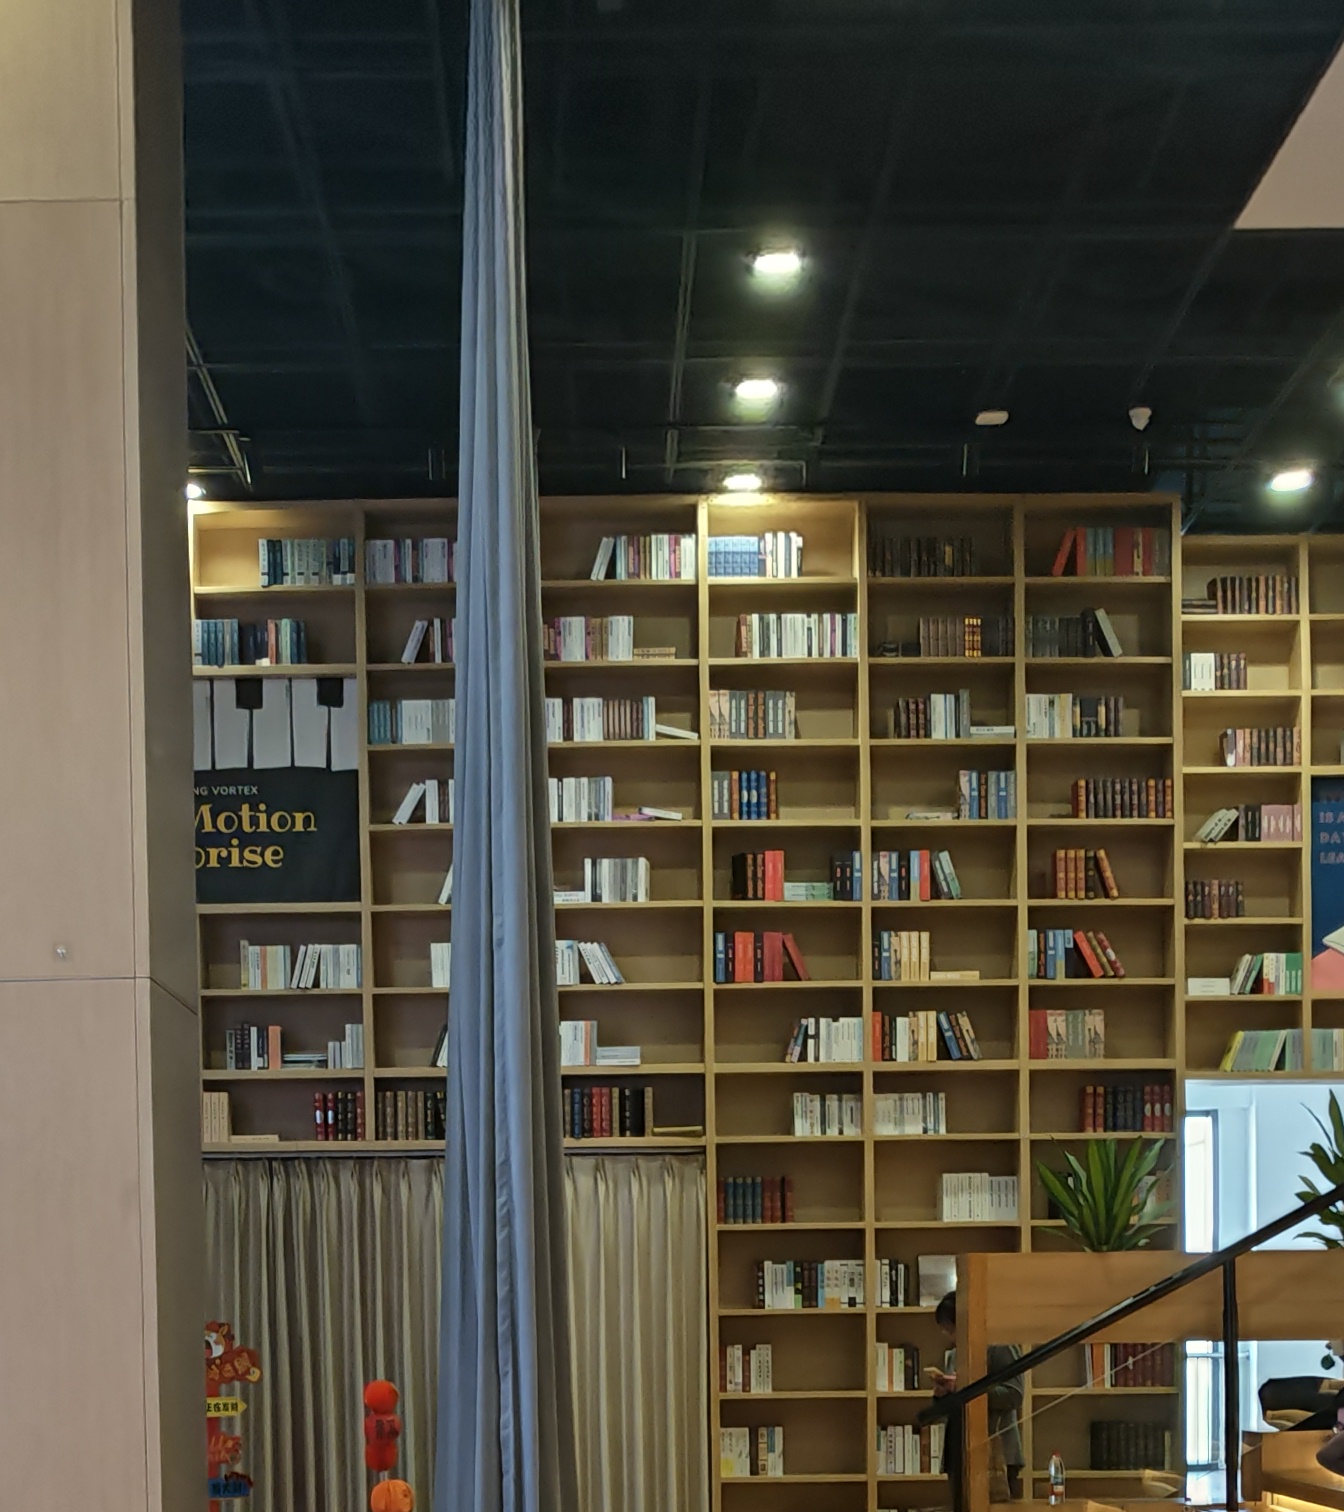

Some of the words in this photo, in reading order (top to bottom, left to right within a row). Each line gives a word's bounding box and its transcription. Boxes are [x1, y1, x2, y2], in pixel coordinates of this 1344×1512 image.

[211, 785, 259, 796] VORTEX
[194, 802, 318, 834] Motion
[1318, 811, 1334, 824] IS
